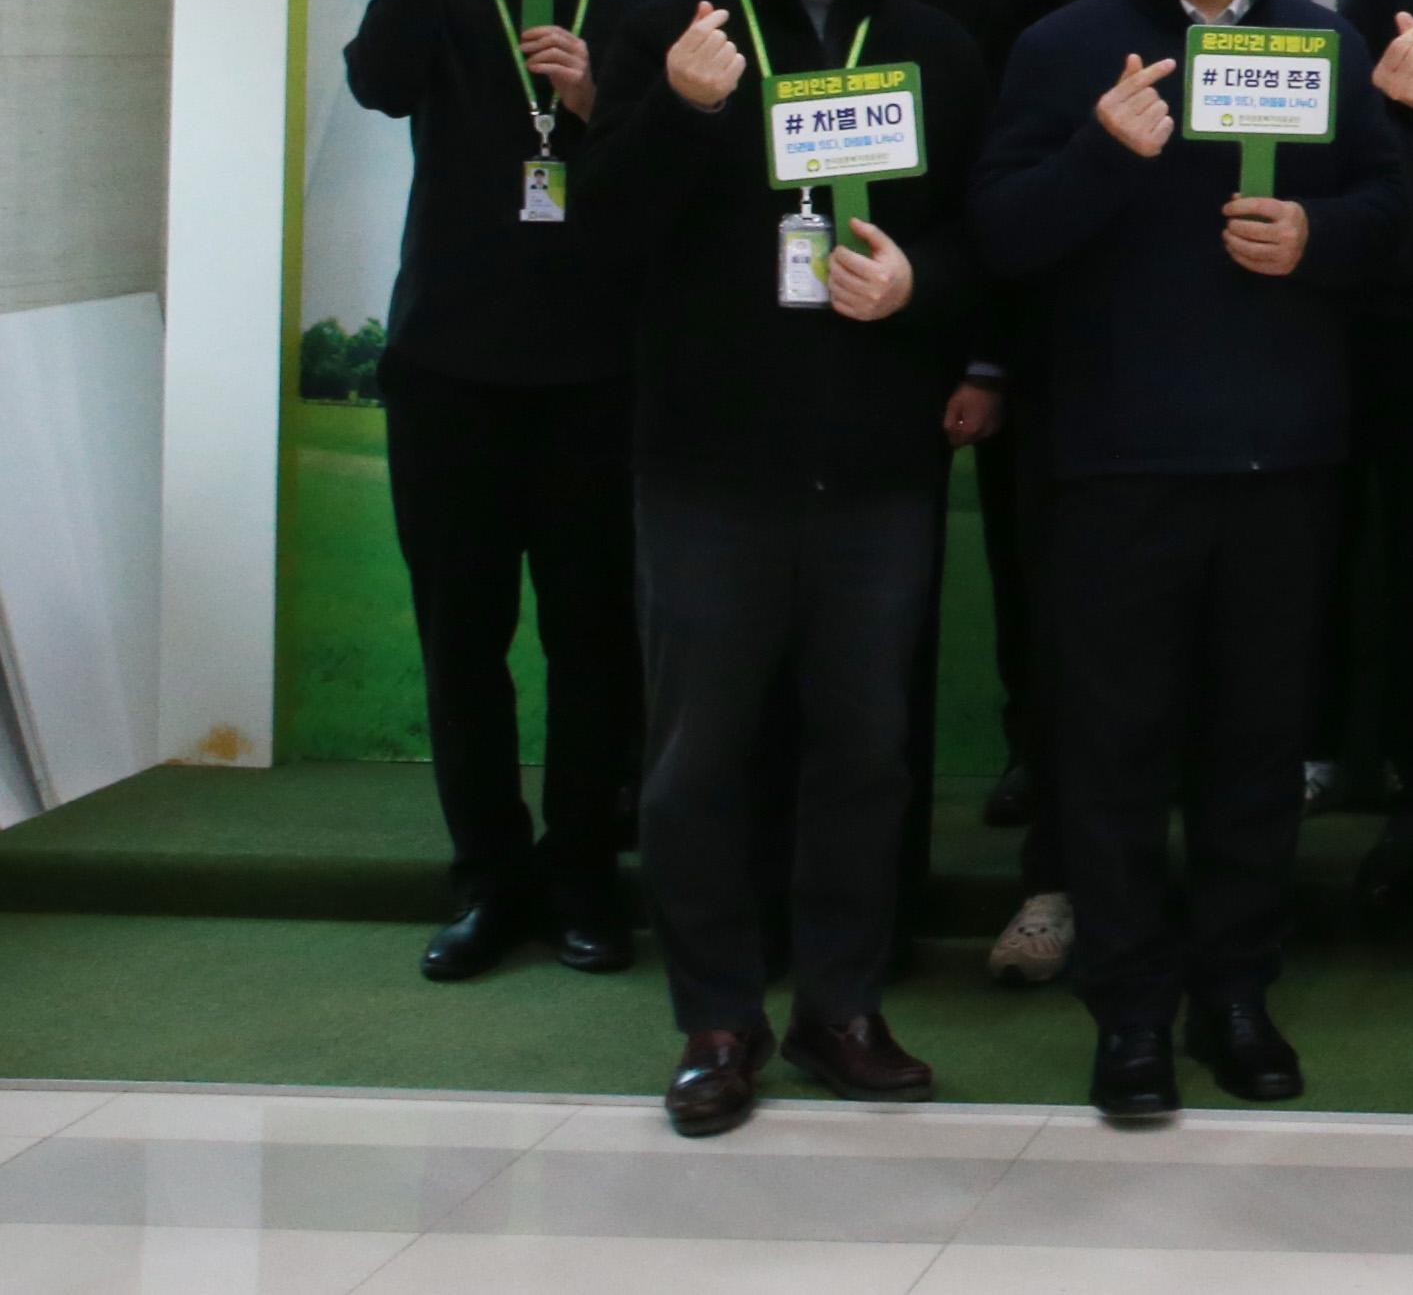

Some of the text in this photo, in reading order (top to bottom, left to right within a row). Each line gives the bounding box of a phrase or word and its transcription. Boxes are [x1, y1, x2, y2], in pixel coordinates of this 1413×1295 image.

[1202, 68, 1322, 90] # 다양성 존중
[785, 103, 903, 135] # 차별 NO
